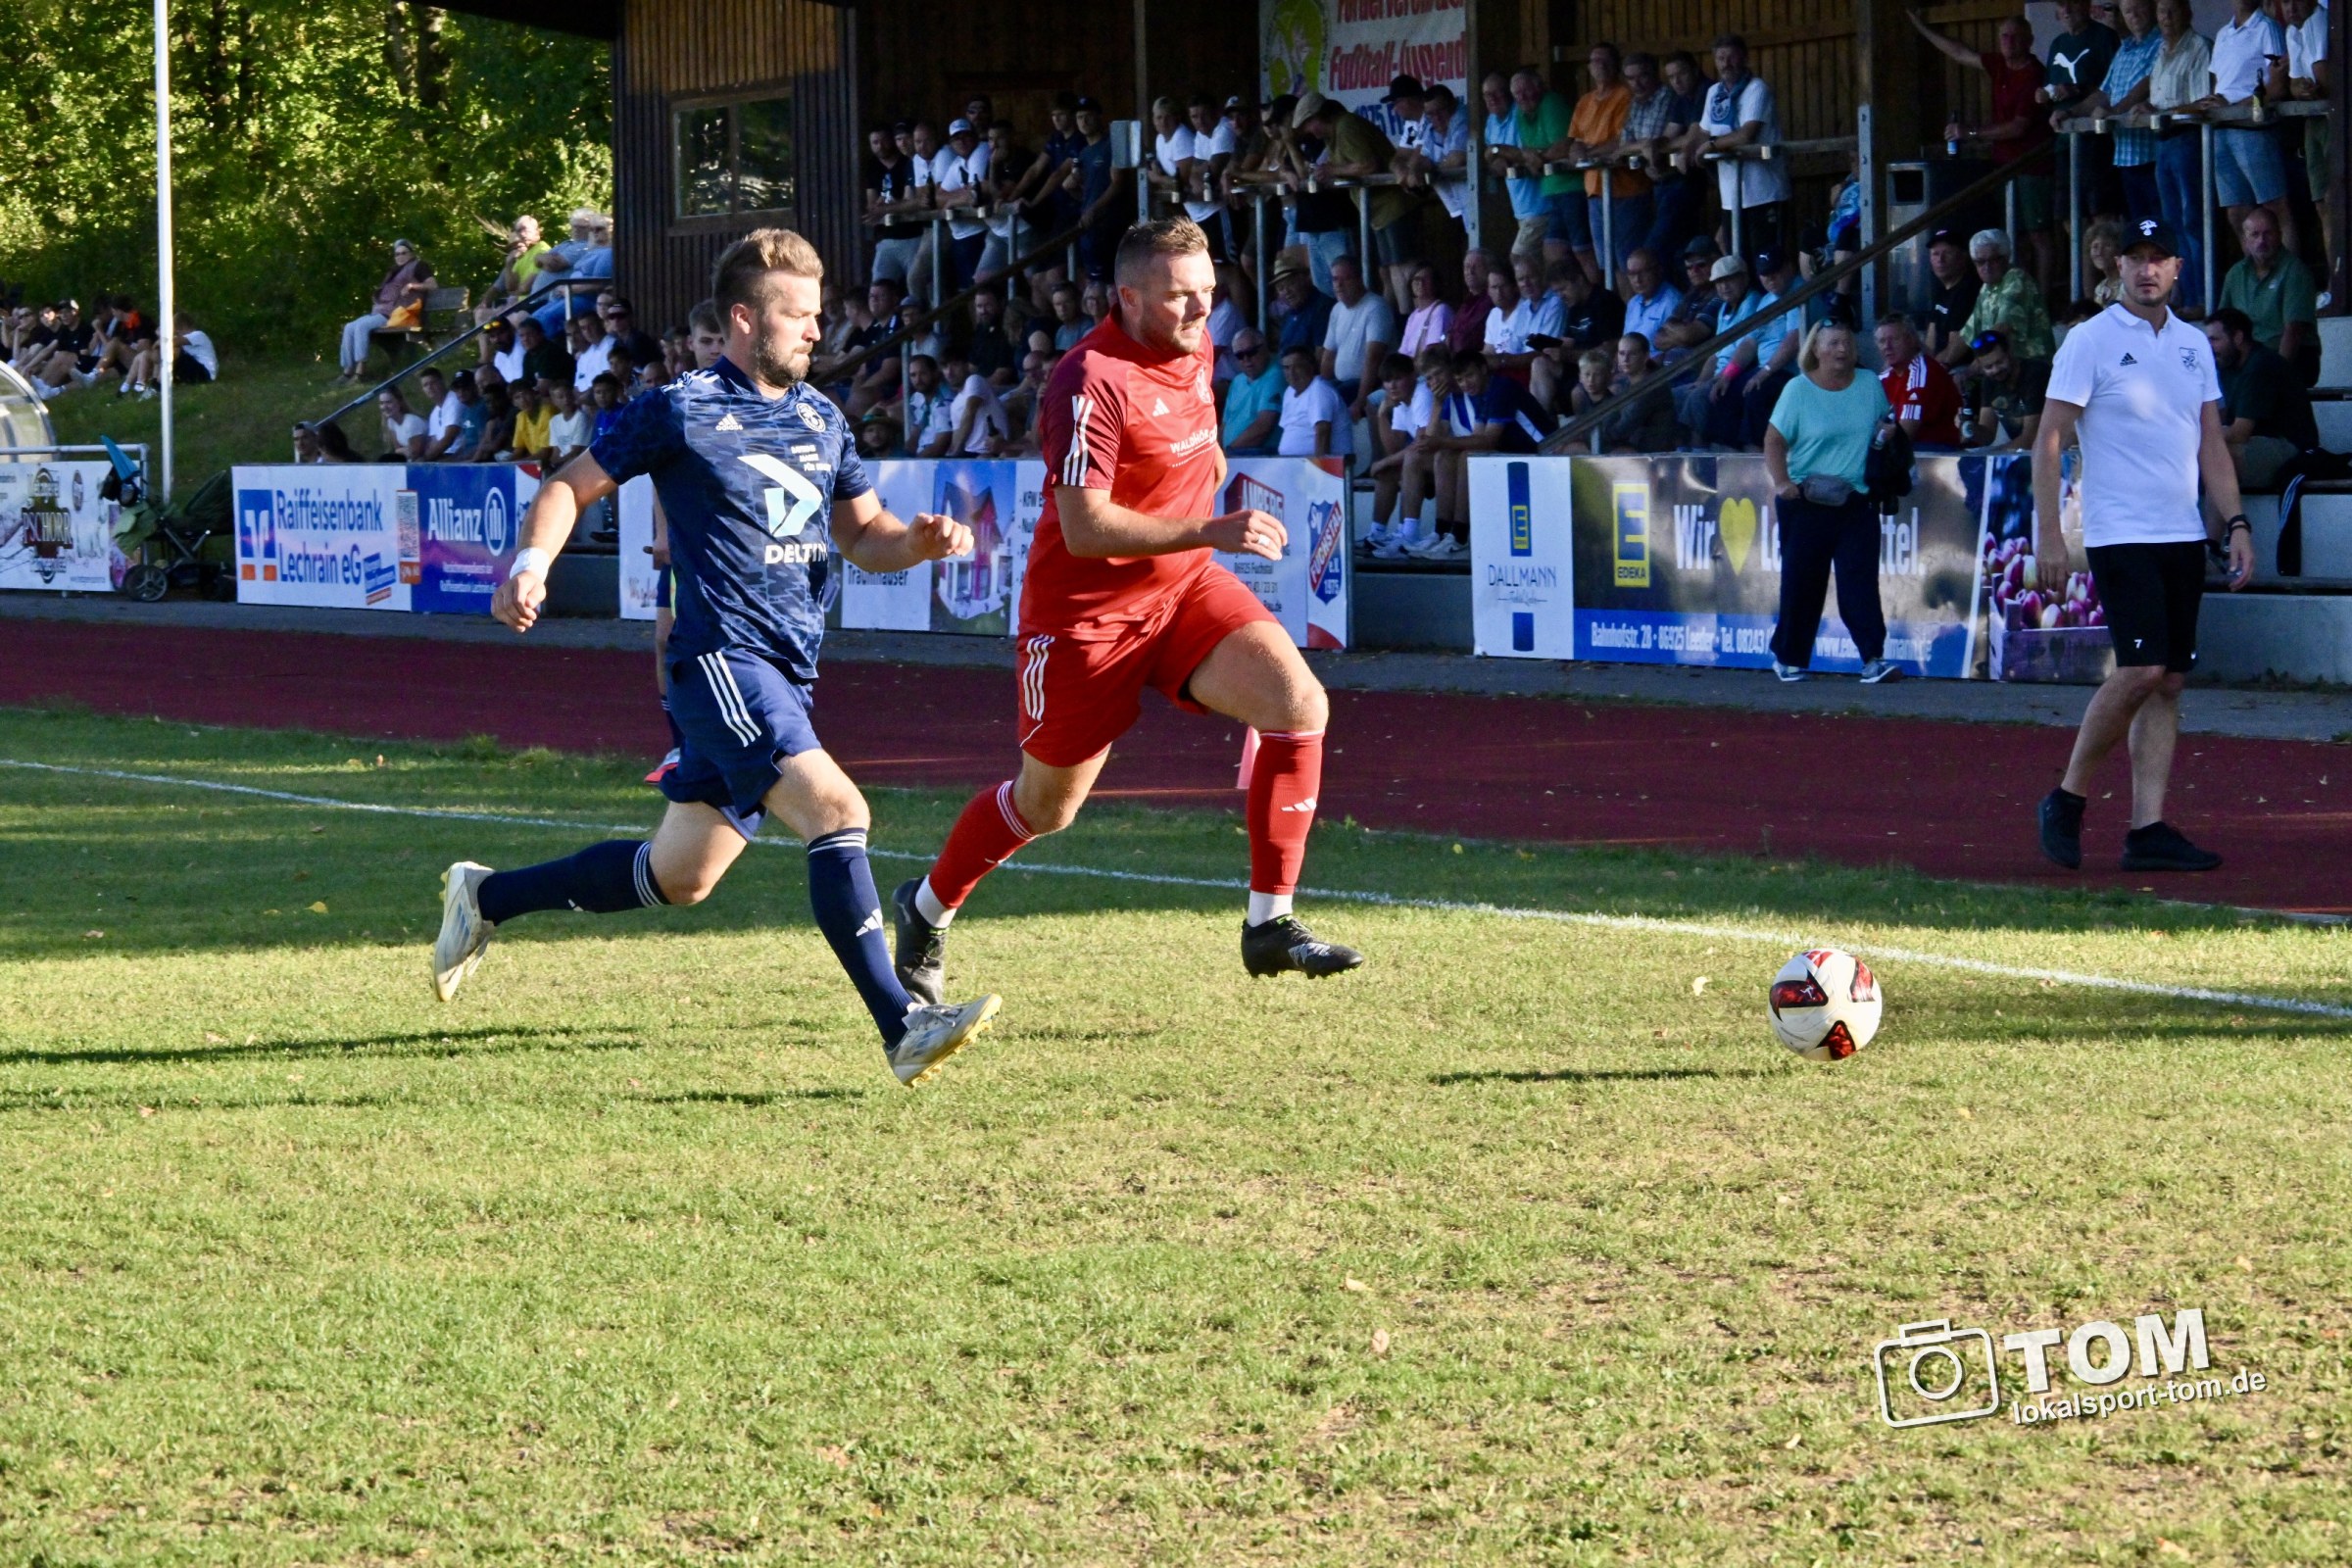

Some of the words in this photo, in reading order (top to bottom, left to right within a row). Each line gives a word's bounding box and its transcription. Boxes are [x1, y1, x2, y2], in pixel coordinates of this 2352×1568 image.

[276, 488, 383, 531] Raiffeisenbank
[427, 498, 482, 541] Allianz
[1674, 504, 1716, 570] Wir
[279, 542, 337, 584] Lechrain
[341, 543, 362, 586] eG
[1488, 564, 1557, 588] DALLMANN
[1618, 565, 1647, 579] EDEKA
[1591, 621, 1640, 649] Bahnhofstr.
[1686, 625, 1715, 652] Leeder
[1721, 626, 1735, 653] Tel.
